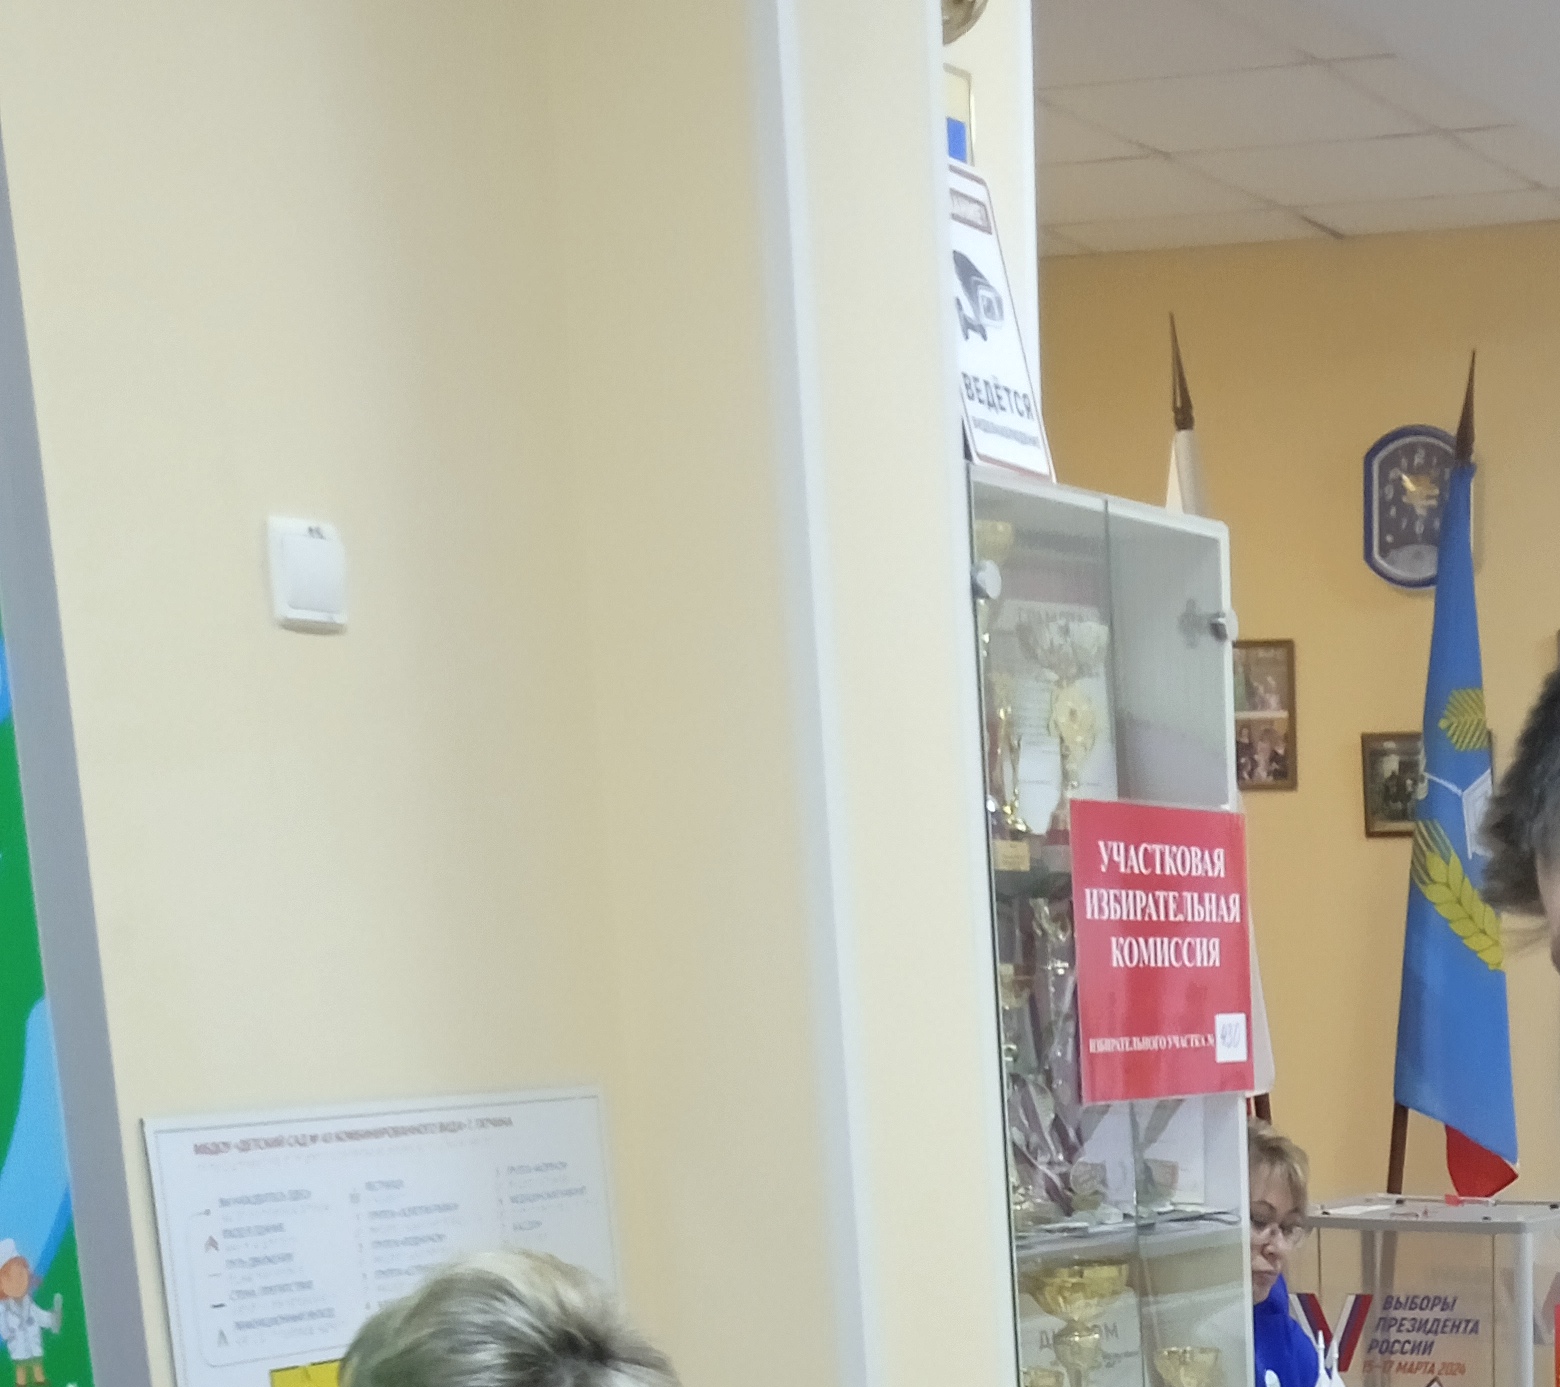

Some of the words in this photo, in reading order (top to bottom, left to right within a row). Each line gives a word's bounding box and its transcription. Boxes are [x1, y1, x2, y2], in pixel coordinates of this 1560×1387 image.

[962, 371, 1034, 420] ВЕДЁТСЯ
[1098, 840, 1226, 878] УЧАСТКОВАЯ
[1085, 888, 1241, 923] ИЗБИРАТЕЛЬНАЯ
[1111, 936, 1221, 968] КОМИССИЯ
[1382, 1295, 1457, 1312] ВЫБОРЫ
[1375, 1317, 1480, 1336] ПРЕЗИДЕНТА
[1367, 1339, 1435, 1356] РОССИИ
[1395, 1361, 1435, 1375] МАРТА
